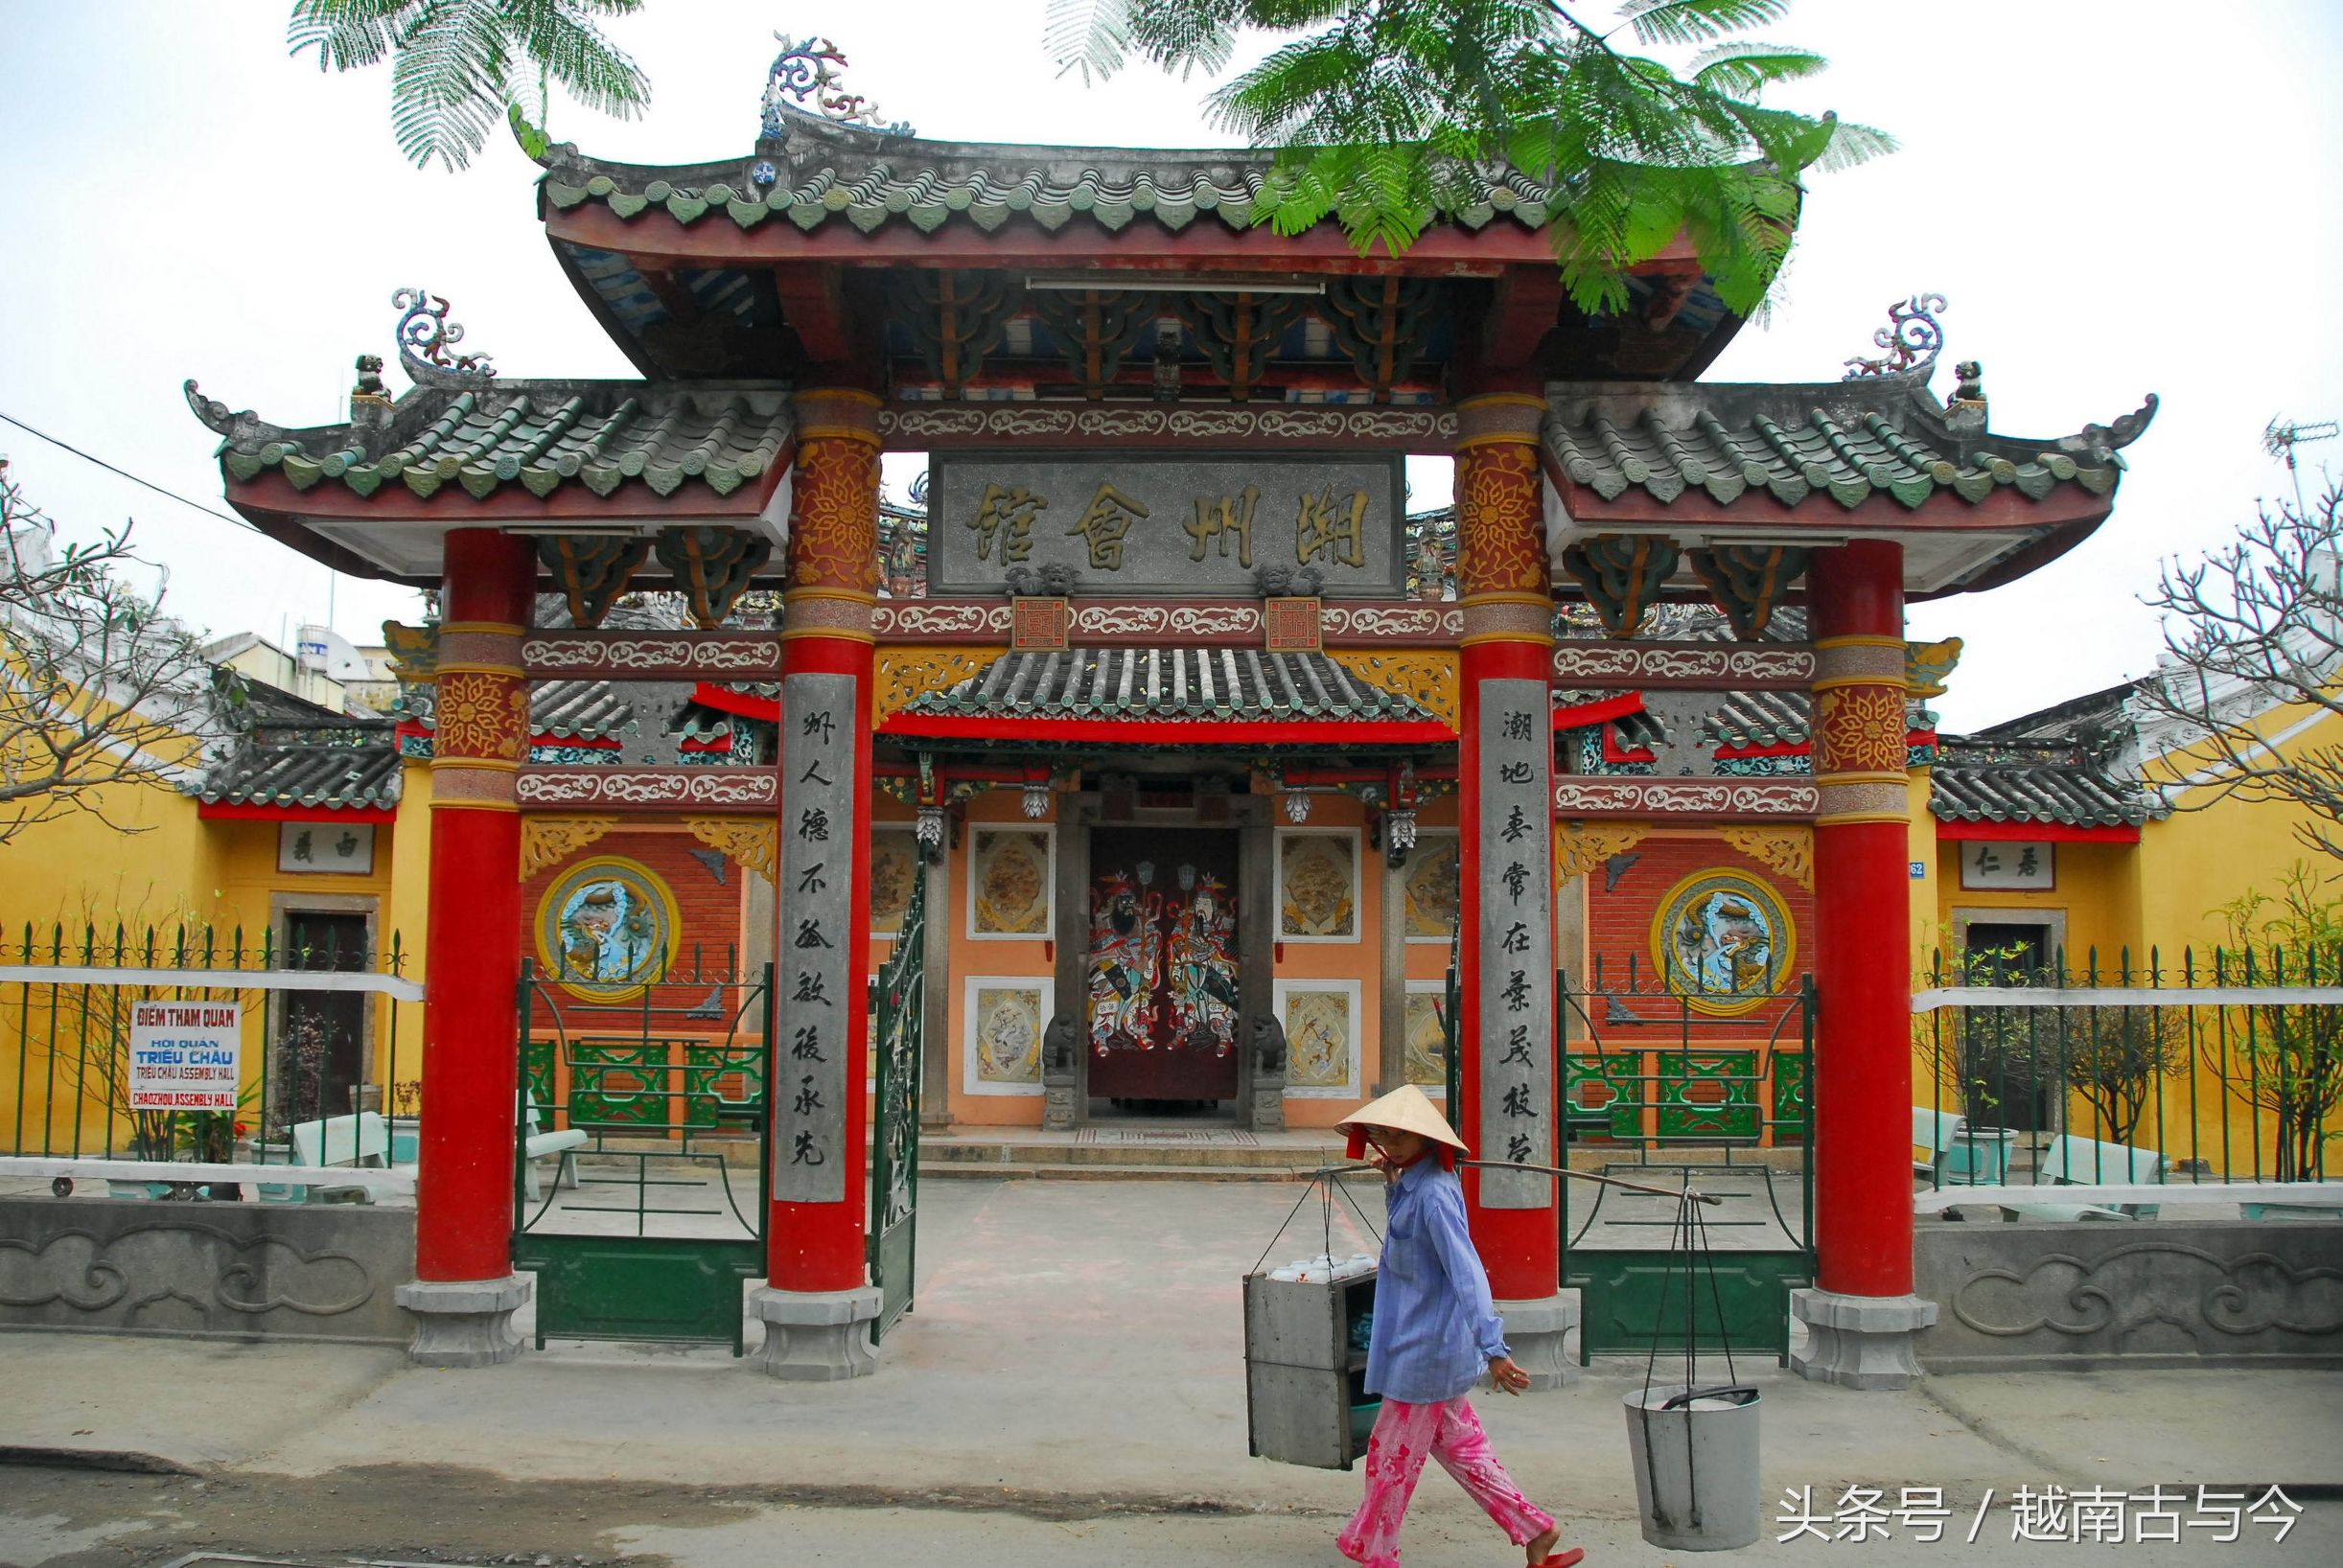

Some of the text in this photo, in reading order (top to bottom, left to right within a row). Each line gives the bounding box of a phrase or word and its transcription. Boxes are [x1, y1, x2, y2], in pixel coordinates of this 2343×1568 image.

[965, 481, 1370, 571] 潮州會館
[1911, 863, 1923, 875] 62
[168, 1008, 200, 1027] THAM
[203, 1008, 235, 1027] QUAN
[179, 1067, 217, 1080] ASSEMBLY
[218, 1067, 235, 1081] HALL
[133, 1093, 235, 1107] CHAOZHOU ASSEMBLY HALL
